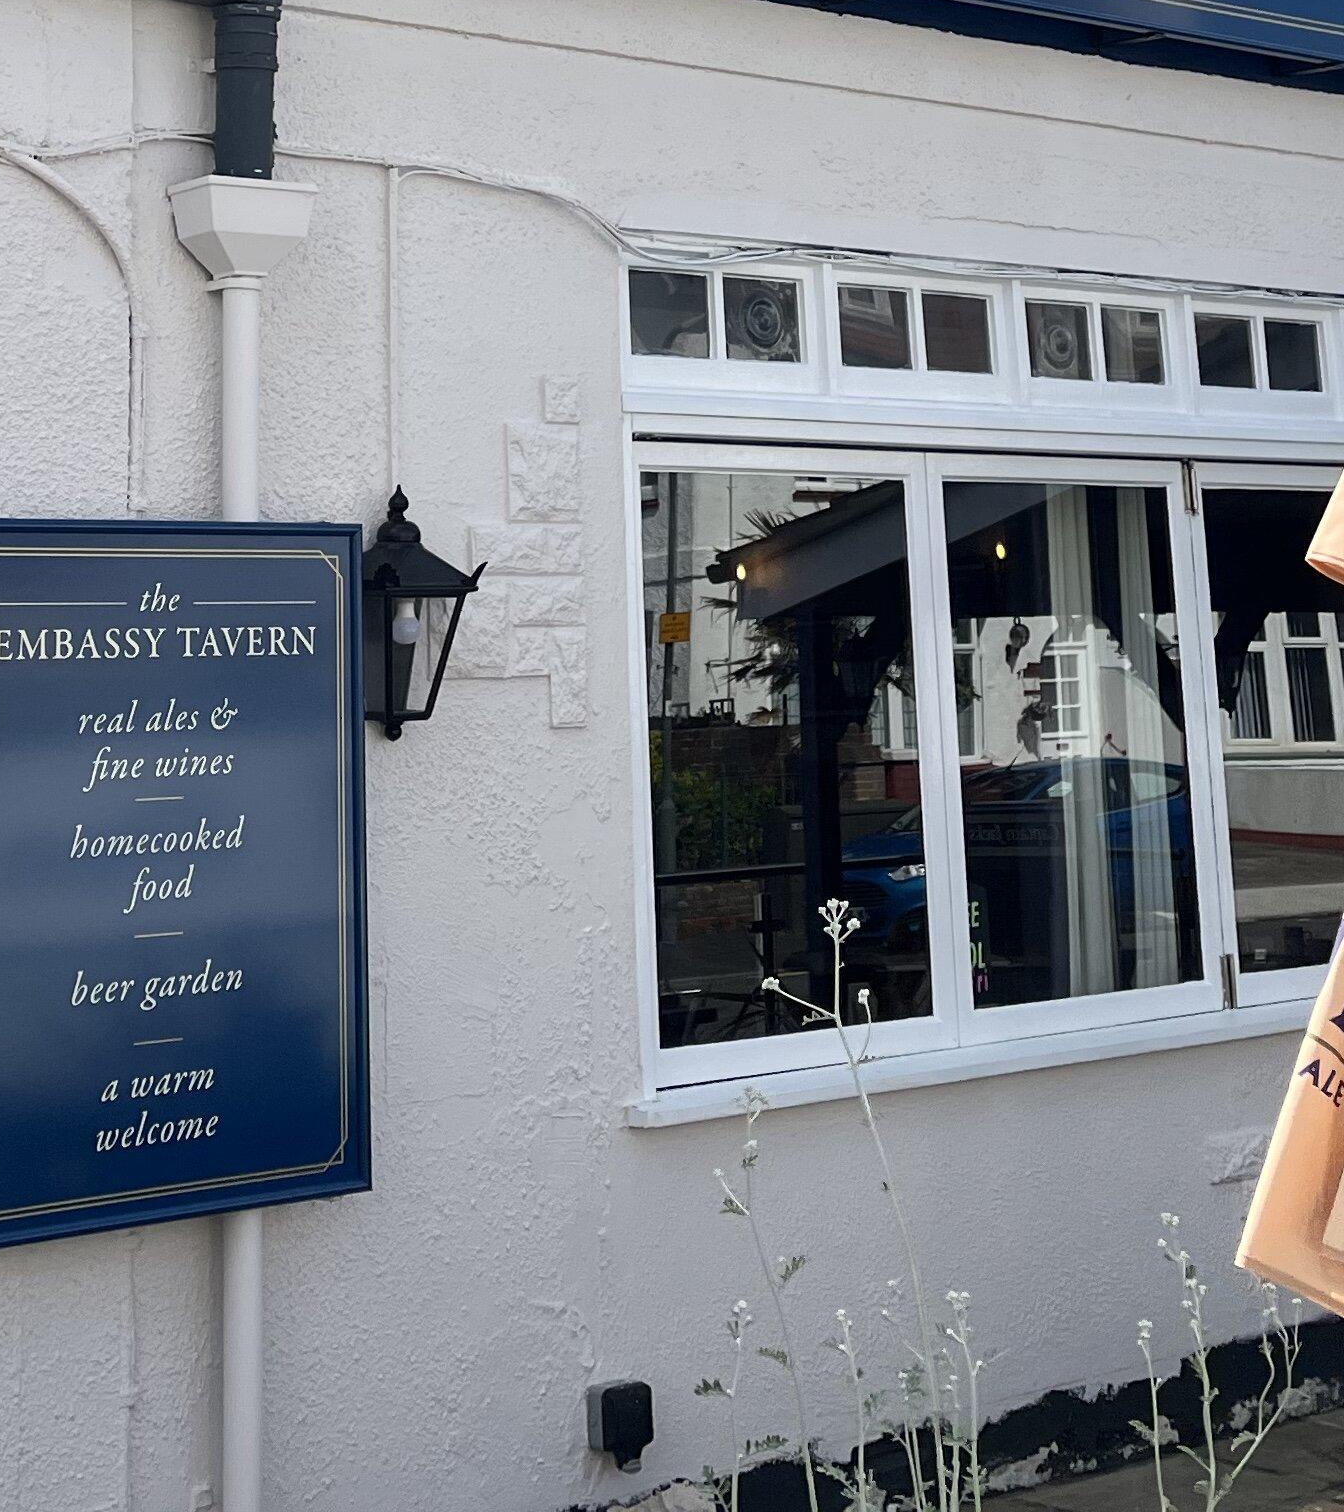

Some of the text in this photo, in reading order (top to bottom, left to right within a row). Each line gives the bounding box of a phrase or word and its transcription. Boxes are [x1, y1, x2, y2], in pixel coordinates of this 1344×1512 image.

[140, 583, 180, 611] the
[177, 627, 316, 657] TAVERN
[79, 698, 238, 734] real ales &
[83, 747, 233, 792] fine wines
[71, 815, 244, 858] homecooked
[124, 864, 194, 913] food
[72, 960, 242, 1010] beer garden
[101, 1069, 214, 1102] a warm
[97, 1111, 218, 1151] welcome
